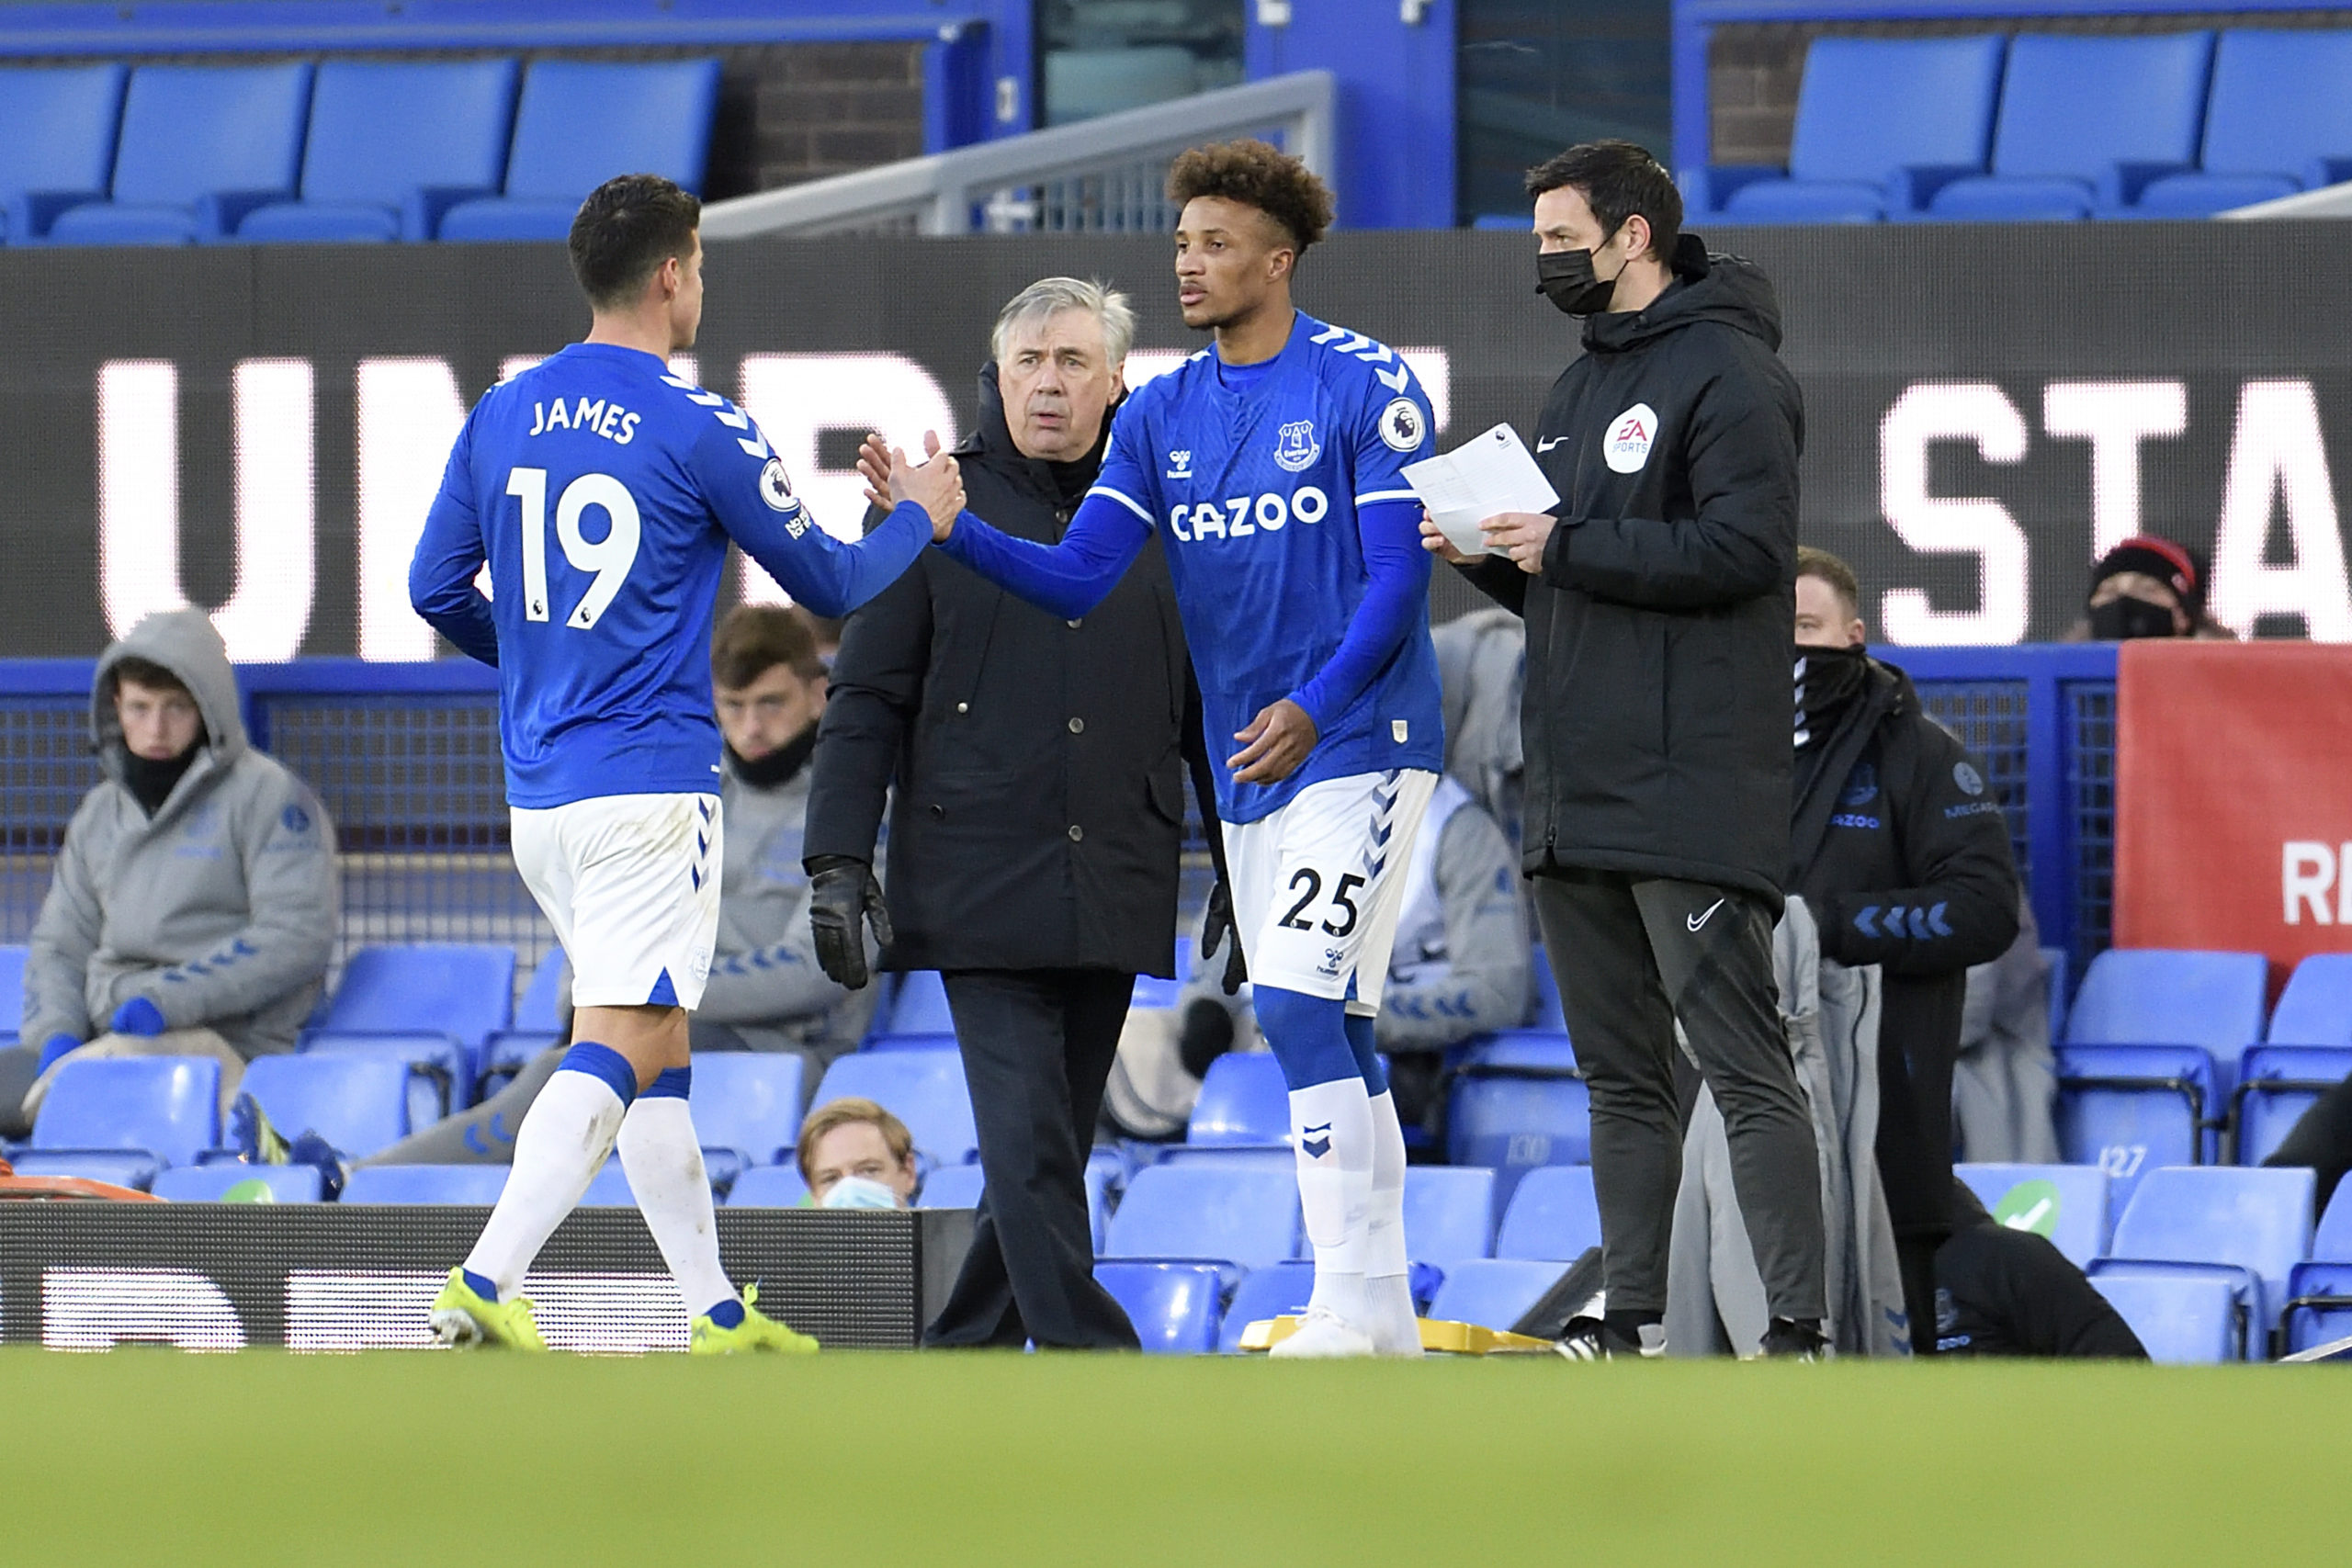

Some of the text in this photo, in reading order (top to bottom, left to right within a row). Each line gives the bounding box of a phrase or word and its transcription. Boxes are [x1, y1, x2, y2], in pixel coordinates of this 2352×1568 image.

[529, 397, 642, 446] JAMES
[1616, 418, 1647, 442] EA
[1611, 442, 1649, 454] SPORTS
[1170, 485, 1329, 542] CAZOO
[506, 467, 641, 630] 19
[1830, 813, 1881, 829] AZOO
[1277, 867, 1366, 938] 25
